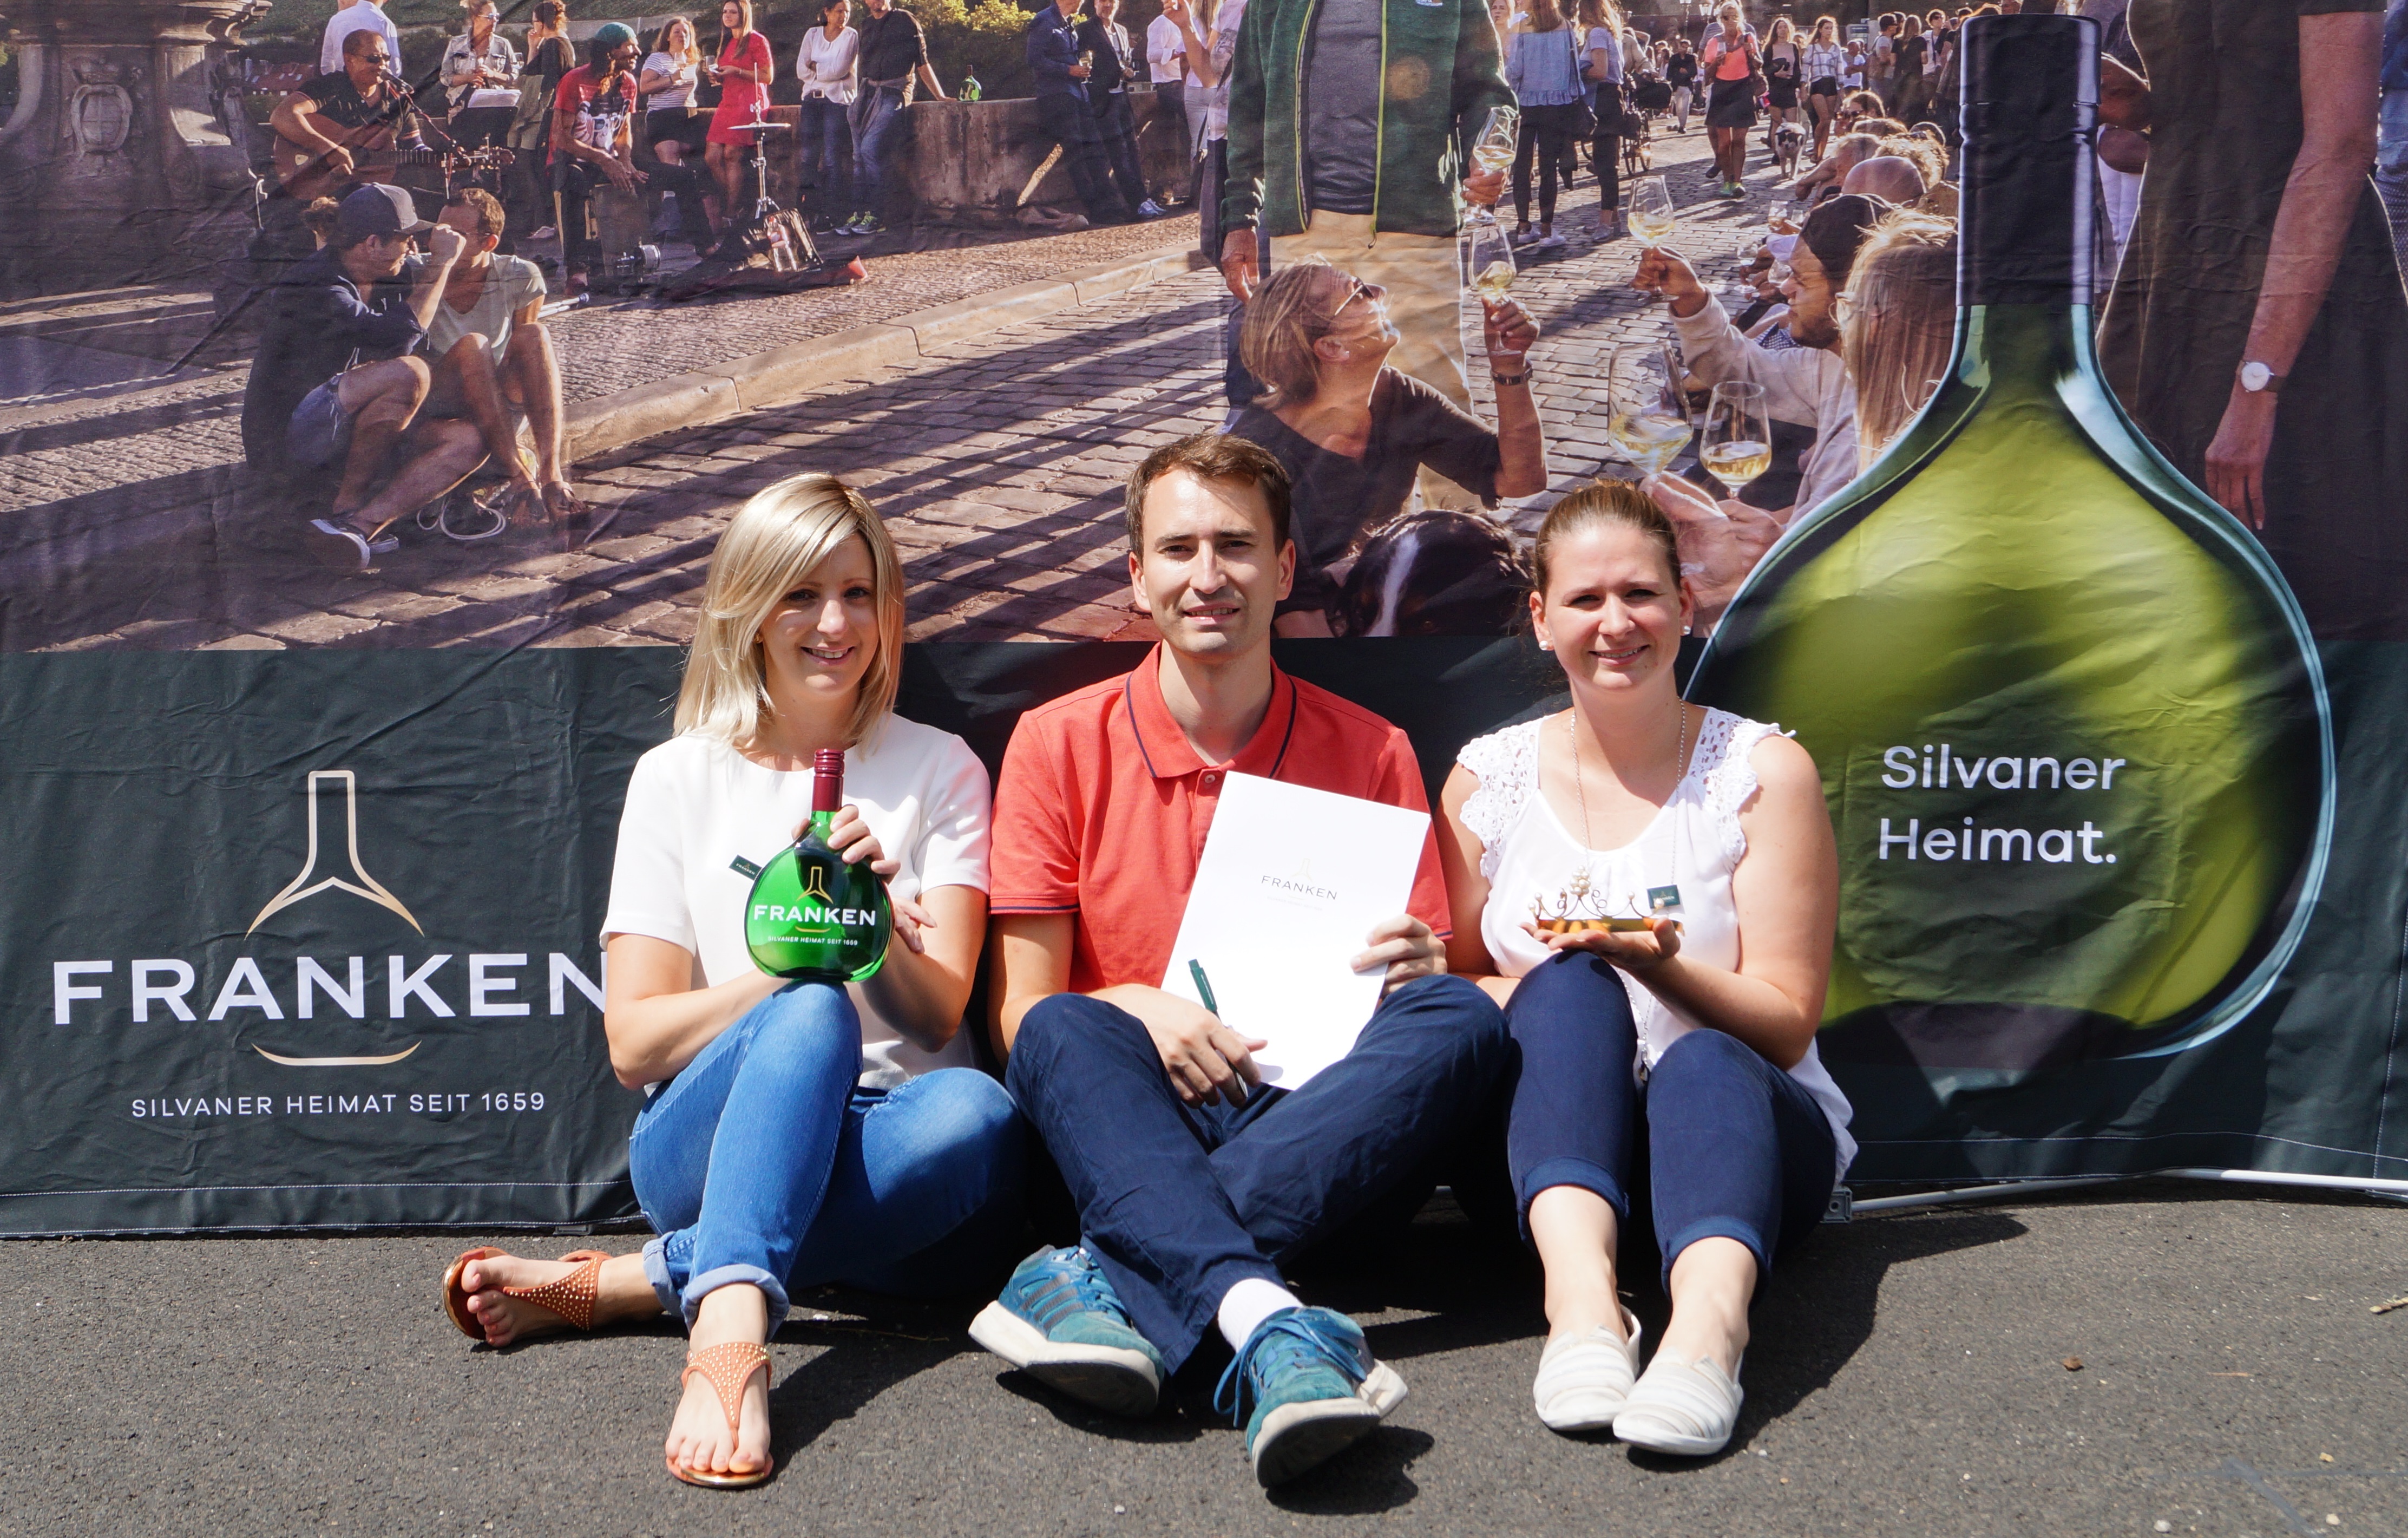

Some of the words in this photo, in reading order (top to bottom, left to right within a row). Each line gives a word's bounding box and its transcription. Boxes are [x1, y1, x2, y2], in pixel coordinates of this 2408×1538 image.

[1881, 743, 2126, 789] Silvaner
[1879, 816, 2116, 863] Heimat.
[1261, 875, 1337, 900] FRANKEN
[753, 905, 876, 926] FRANKEN
[54, 952, 607, 1024] FRANKEN
[132, 1096, 272, 1117] SILVANER
[287, 1094, 397, 1114] HEIMAT
[409, 1094, 470, 1112] SEIT
[481, 1092, 544, 1111] 1659
